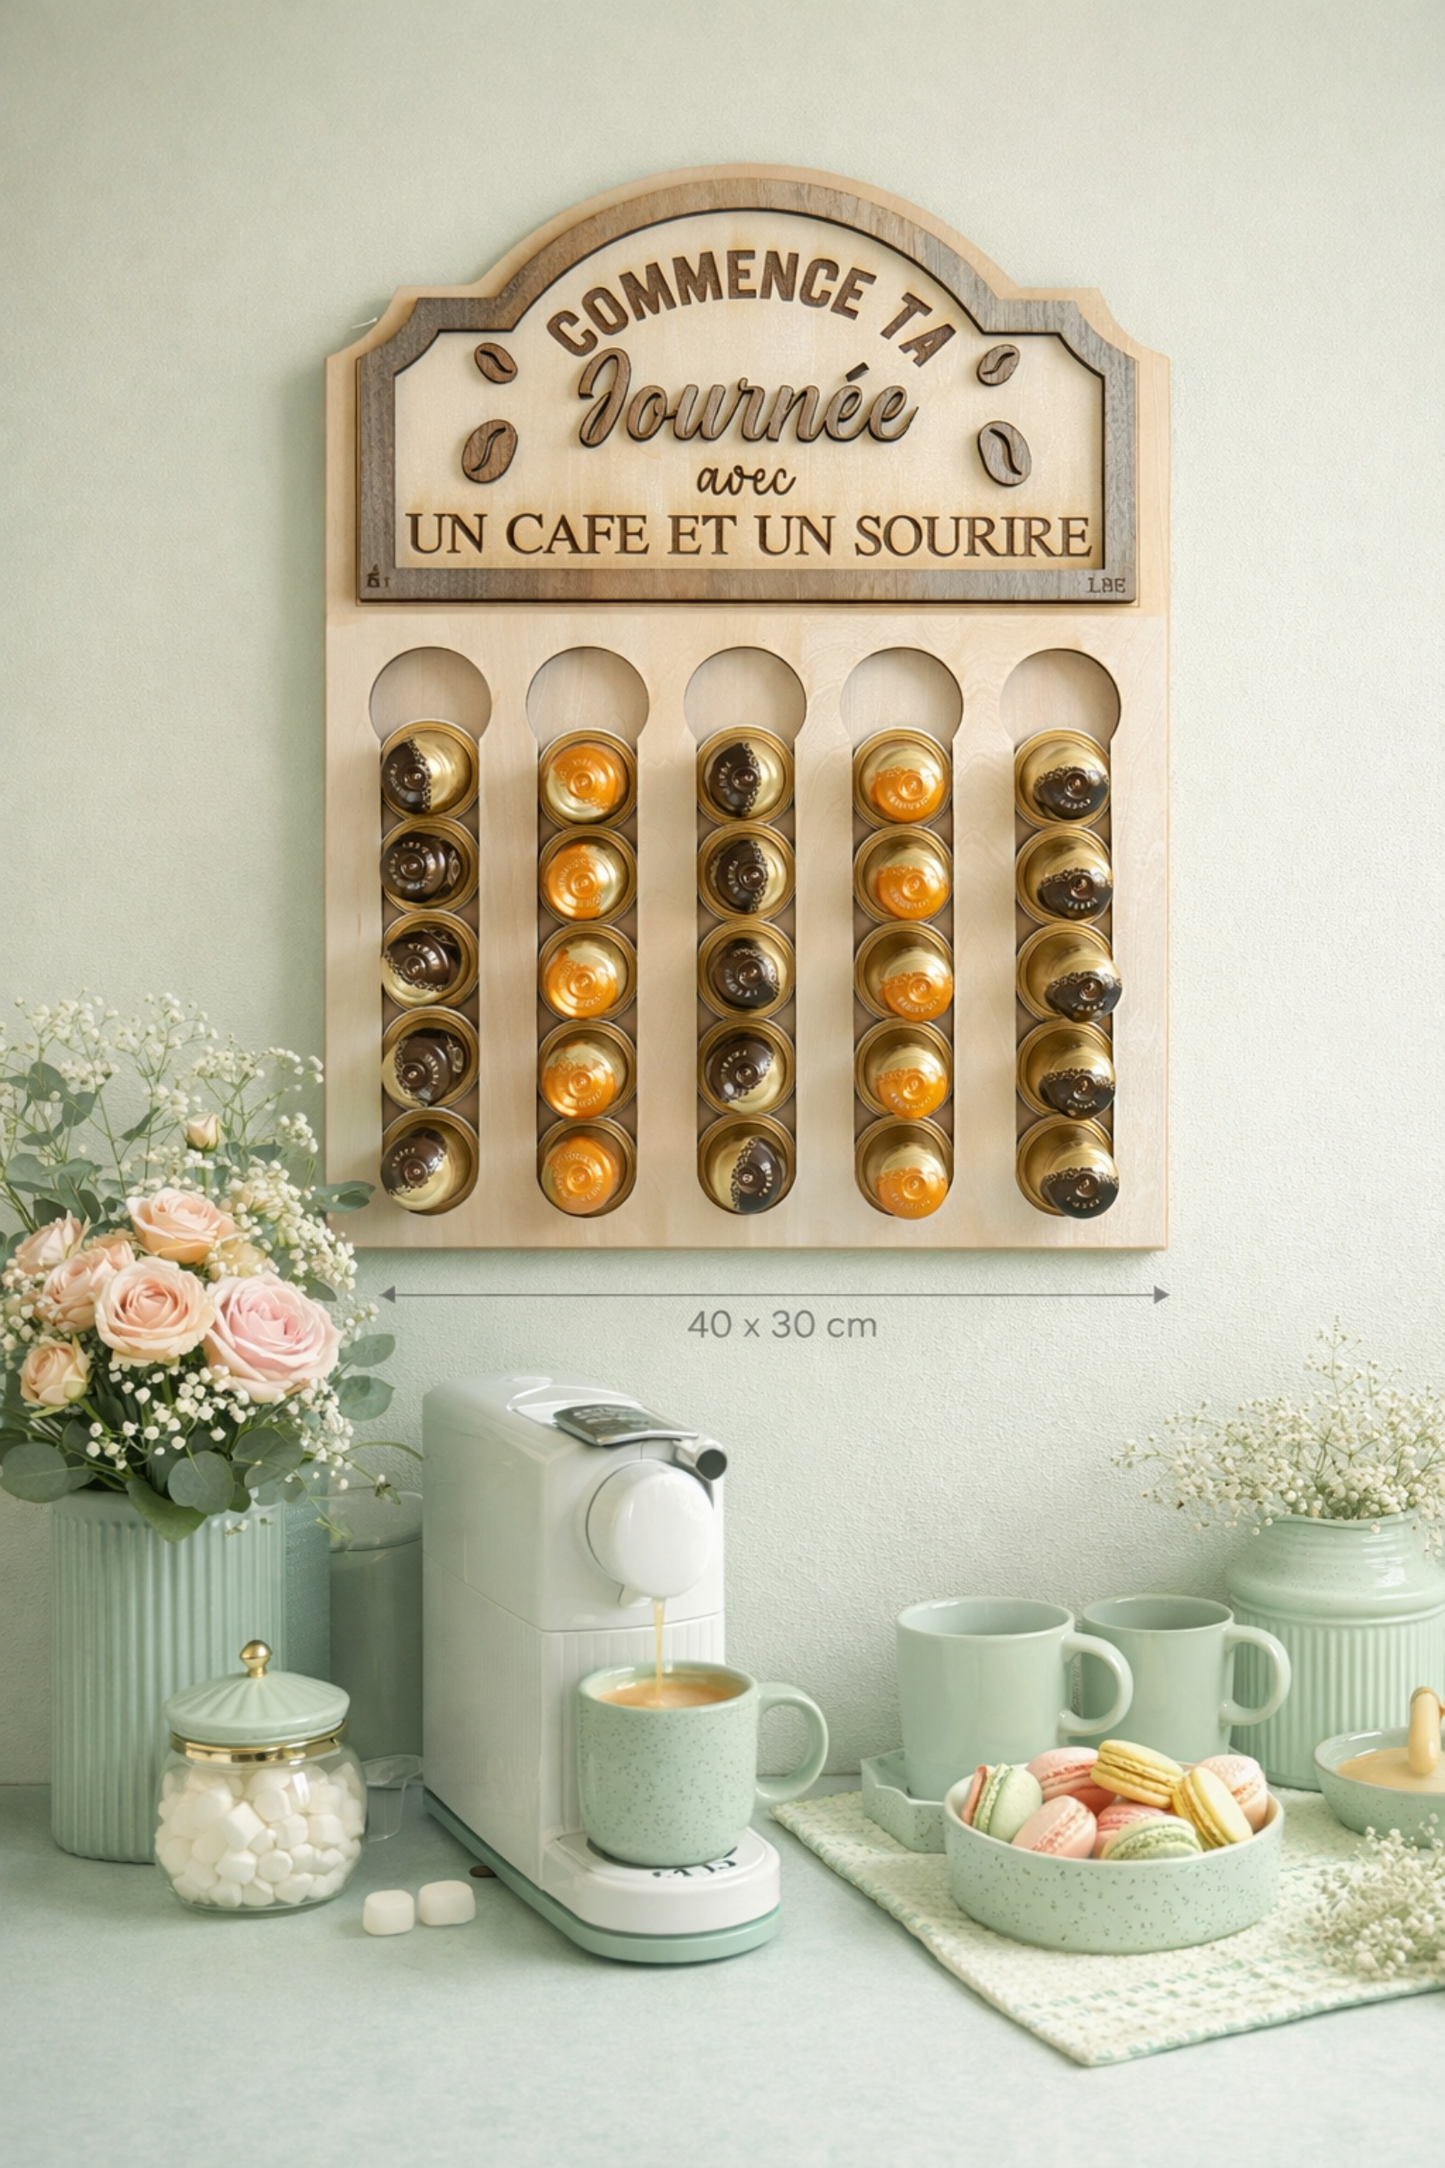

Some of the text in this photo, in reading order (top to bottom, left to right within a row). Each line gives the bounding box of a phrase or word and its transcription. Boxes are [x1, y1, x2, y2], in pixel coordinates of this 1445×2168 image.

[546, 249, 957, 368] COMMENCE TA
[577, 347, 919, 447] Journée
[695, 464, 797, 496] avec
[405, 513, 1093, 558] UN CAFE ET UN SOURIRE
